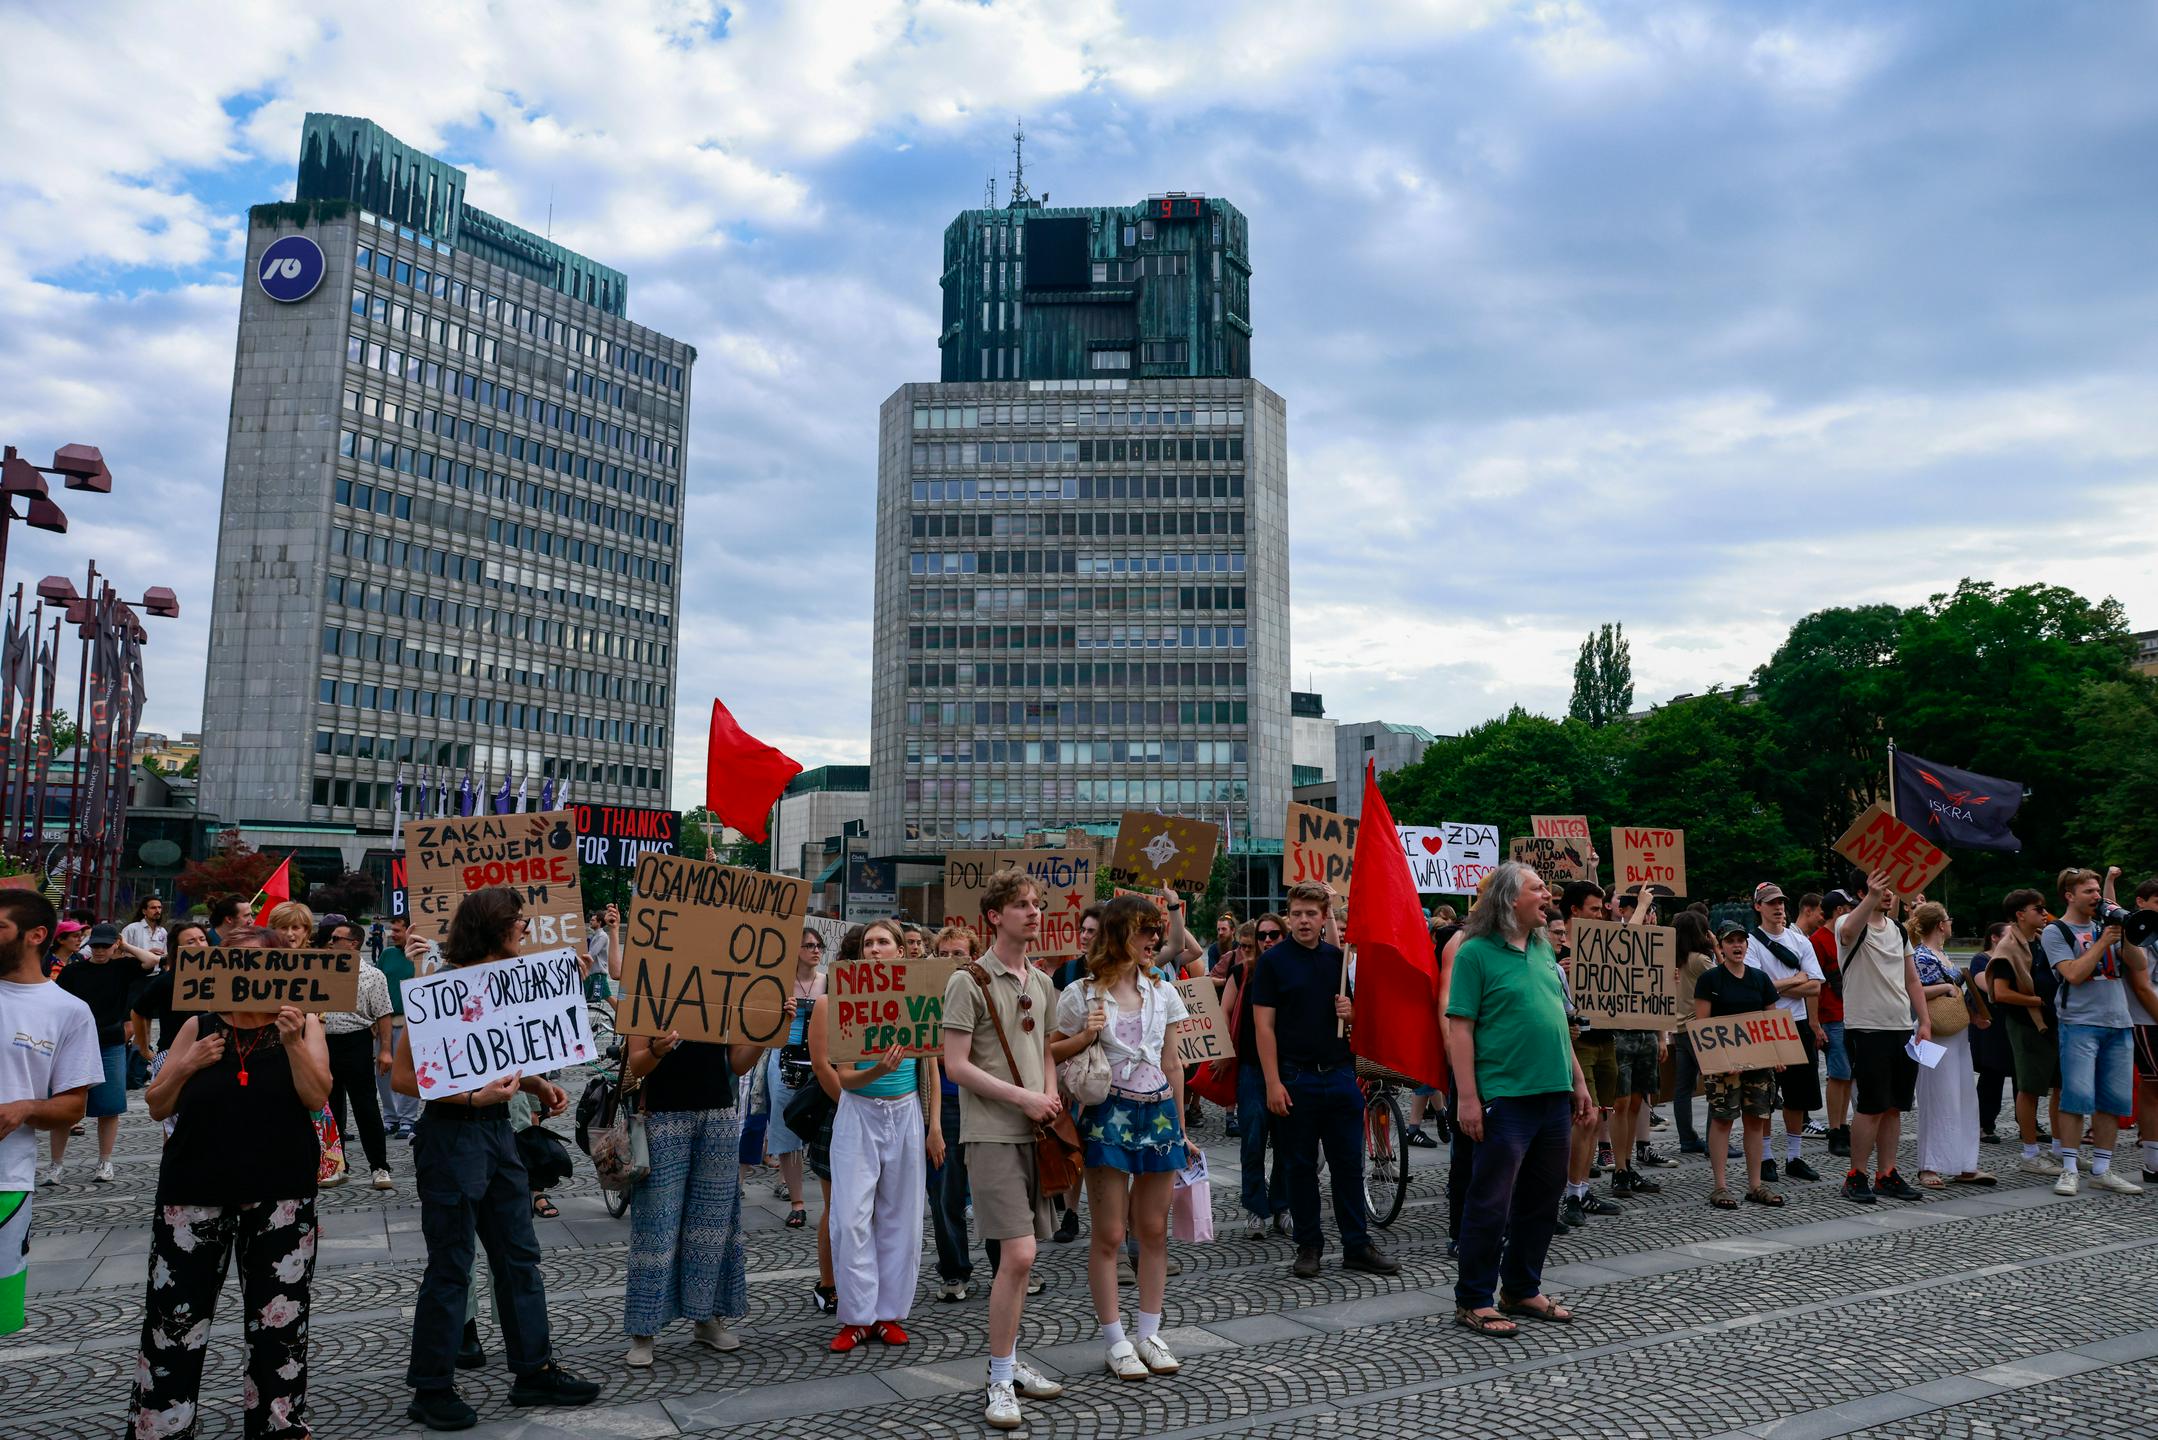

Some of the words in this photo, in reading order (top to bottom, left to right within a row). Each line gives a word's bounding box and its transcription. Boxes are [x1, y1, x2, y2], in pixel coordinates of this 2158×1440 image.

[1161, 199, 1172, 218] 9
[1190, 199, 1200, 217] 7
[82, 801, 92, 837] OURMET
[87, 763, 100, 799] MARKET
[1929, 799, 1974, 823] ISKRA
[416, 819, 507, 848] ZAKAJ
[601, 807, 673, 840] THANKS
[1299, 812, 1360, 850] NAT
[421, 837, 544, 870] PLAČUJEM
[576, 836, 610, 866] FOR
[1525, 838, 1555, 853] NATO
[1625, 829, 1675, 850] NATO
[1536, 849, 1567, 861] VLADA
[1027, 856, 1090, 889] NATOM
[1109, 867, 1128, 881] EU
[1173, 877, 1206, 892] NATO
[1412, 858, 1452, 888] WAR
[1626, 866, 1675, 883] BLATO
[420, 886, 450, 914] ČE
[636, 855, 798, 921] OSAMOSVOJMO
[631, 908, 679, 952] SE
[729, 923, 787, 969] OD
[817, 919, 848, 938] NATO
[1576, 924, 1664, 969] KAKŠNE
[182, 976, 216, 1001] JE
[231, 976, 330, 1003] BUTEL
[407, 978, 469, 1025] STOP
[631, 957, 788, 1043] NATO
[1575, 993, 1596, 1011] MA
[904, 995, 946, 1023] VA
[864, 1022, 945, 1051] PROFI
[1178, 1034, 1222, 1060] NKE
[1692, 1017, 1800, 1052] ISRAHELL
